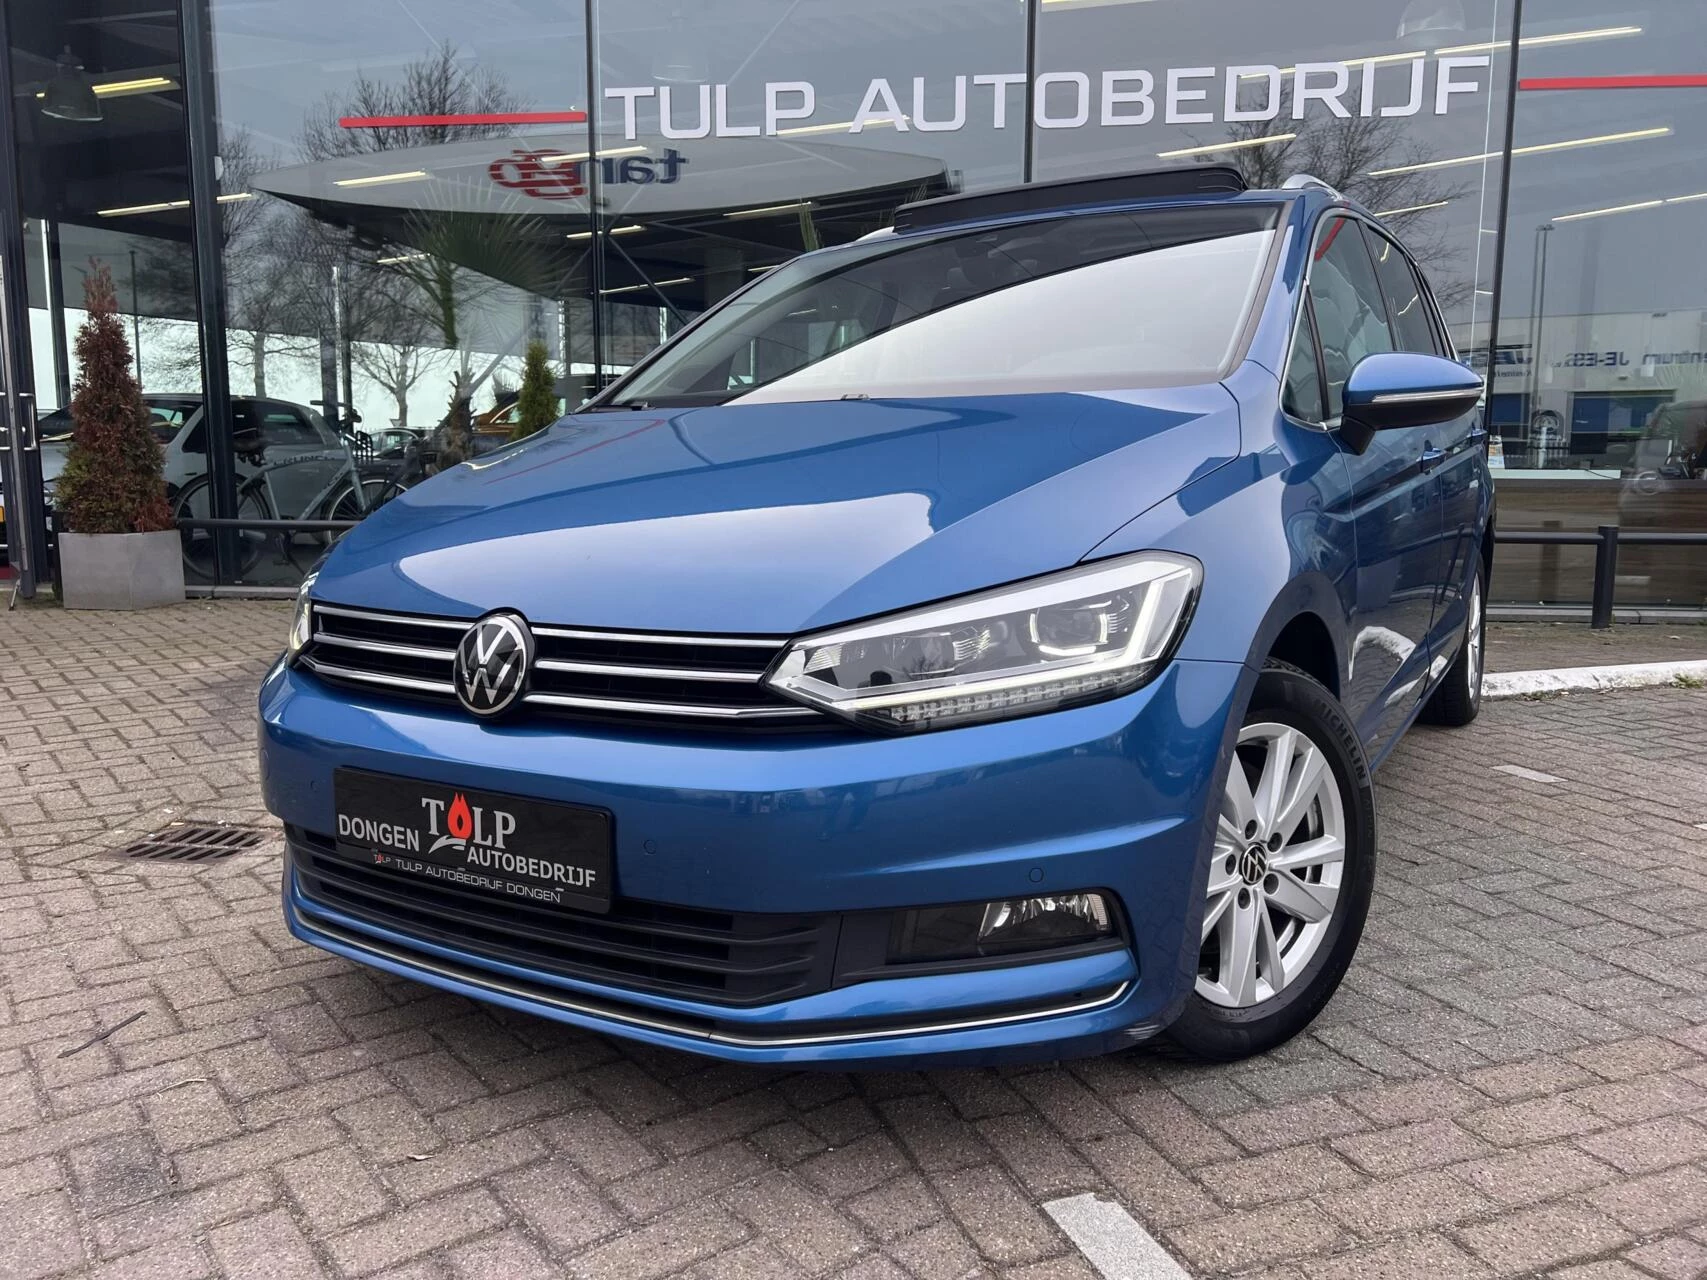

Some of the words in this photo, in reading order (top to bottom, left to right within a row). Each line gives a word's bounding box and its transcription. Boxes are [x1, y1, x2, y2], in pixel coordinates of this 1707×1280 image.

[604, 81, 815, 140] TULP
[848, 55, 1490, 133] AUTOBEDRIJF
[1314, 698, 1367, 780] MICHELIN
[338, 813, 420, 852] DONGEN
[395, 859, 422, 873] TULP
[425, 866, 503, 890] AUTOBEDRIJF
[506, 882, 561, 903] DONGEN
[467, 846, 596, 887] AUTOBEDRIJF
